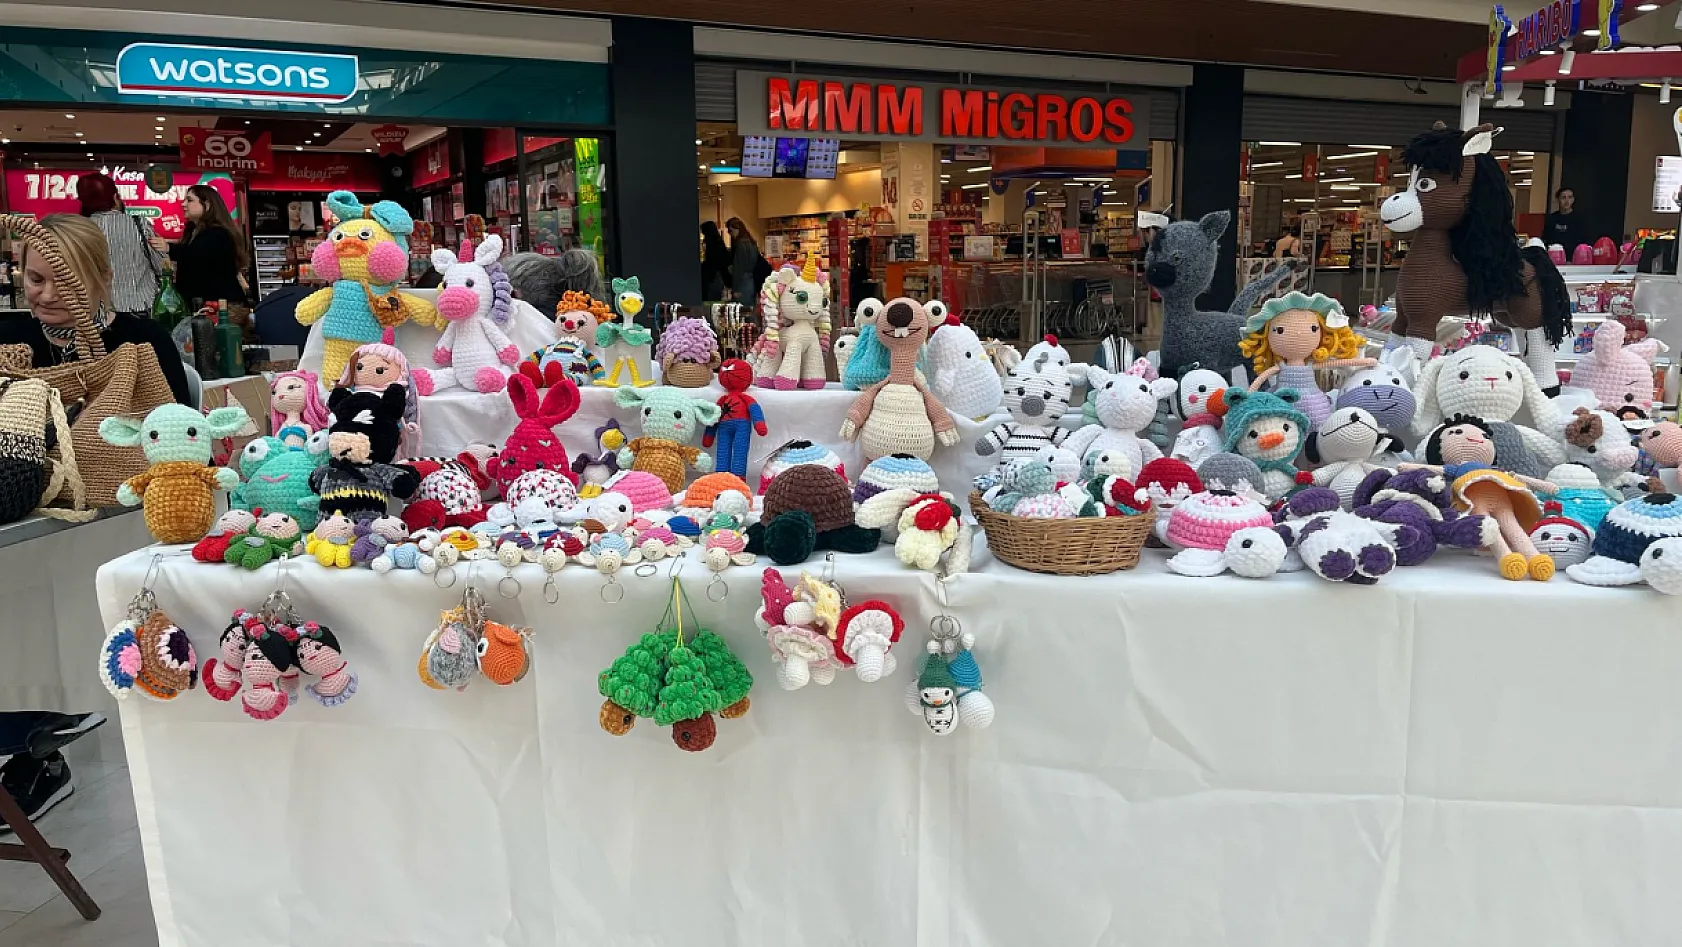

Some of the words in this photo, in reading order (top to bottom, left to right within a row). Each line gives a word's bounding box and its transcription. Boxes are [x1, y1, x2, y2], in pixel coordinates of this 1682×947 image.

[1516, 0, 1571, 59] HARIBO
[150, 57, 330, 89] watsons
[768, 77, 923, 136] MMM
[941, 88, 1135, 144] MiGROS
[113, 165, 145, 181] Kasa
